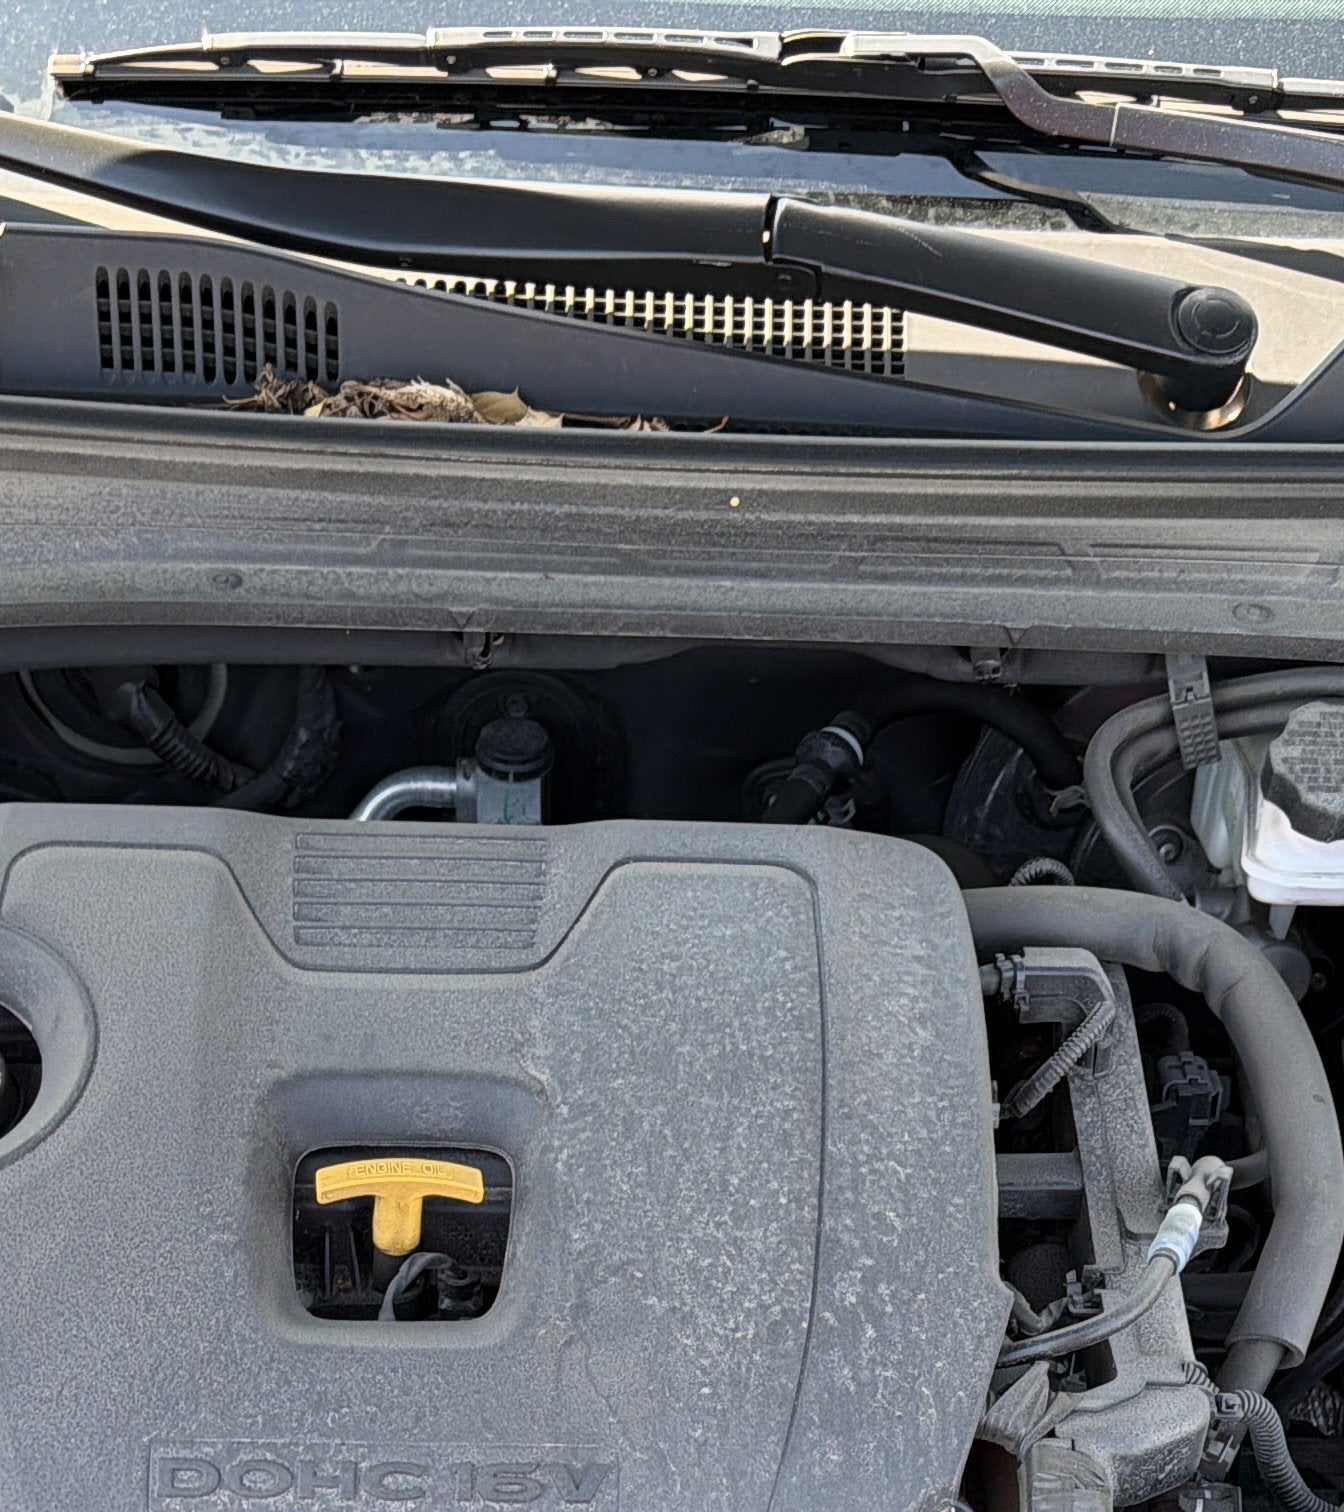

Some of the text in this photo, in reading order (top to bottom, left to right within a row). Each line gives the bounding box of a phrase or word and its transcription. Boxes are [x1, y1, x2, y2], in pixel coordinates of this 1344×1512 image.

[357, 1161, 447, 1176] ENGINE OIL
[155, 1457, 611, 1504] DOHC 16V
